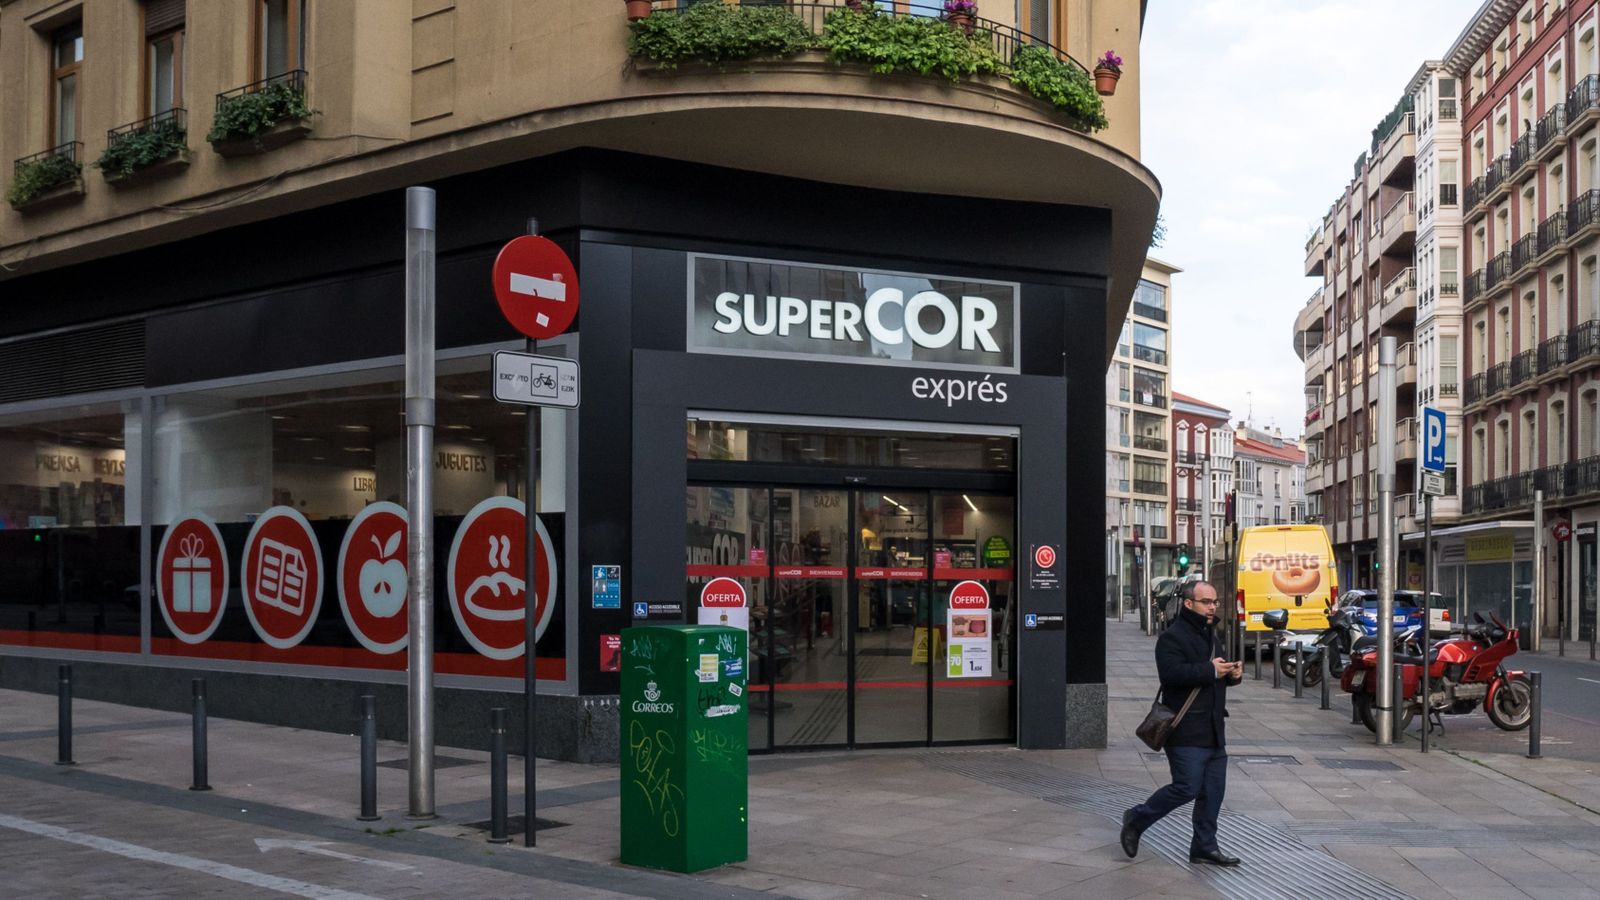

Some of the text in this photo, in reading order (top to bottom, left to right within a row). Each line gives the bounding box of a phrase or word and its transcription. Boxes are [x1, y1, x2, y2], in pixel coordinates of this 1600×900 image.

[713, 287, 1001, 353] SUPERCOR
[499, 373, 529, 383] EXCTO
[911, 374, 1008, 407] exprés
[1428, 414, 1442, 463] P
[36, 454, 80, 473] PRENSA
[435, 452, 487, 472] JUGUETES
[813, 496, 840, 508] BAZAR
[1249, 552, 1320, 572] donuts
[706, 593, 741, 603] OFERTA
[954, 595, 984, 604] OFERTA
[632, 700, 675, 714] CORREOS
